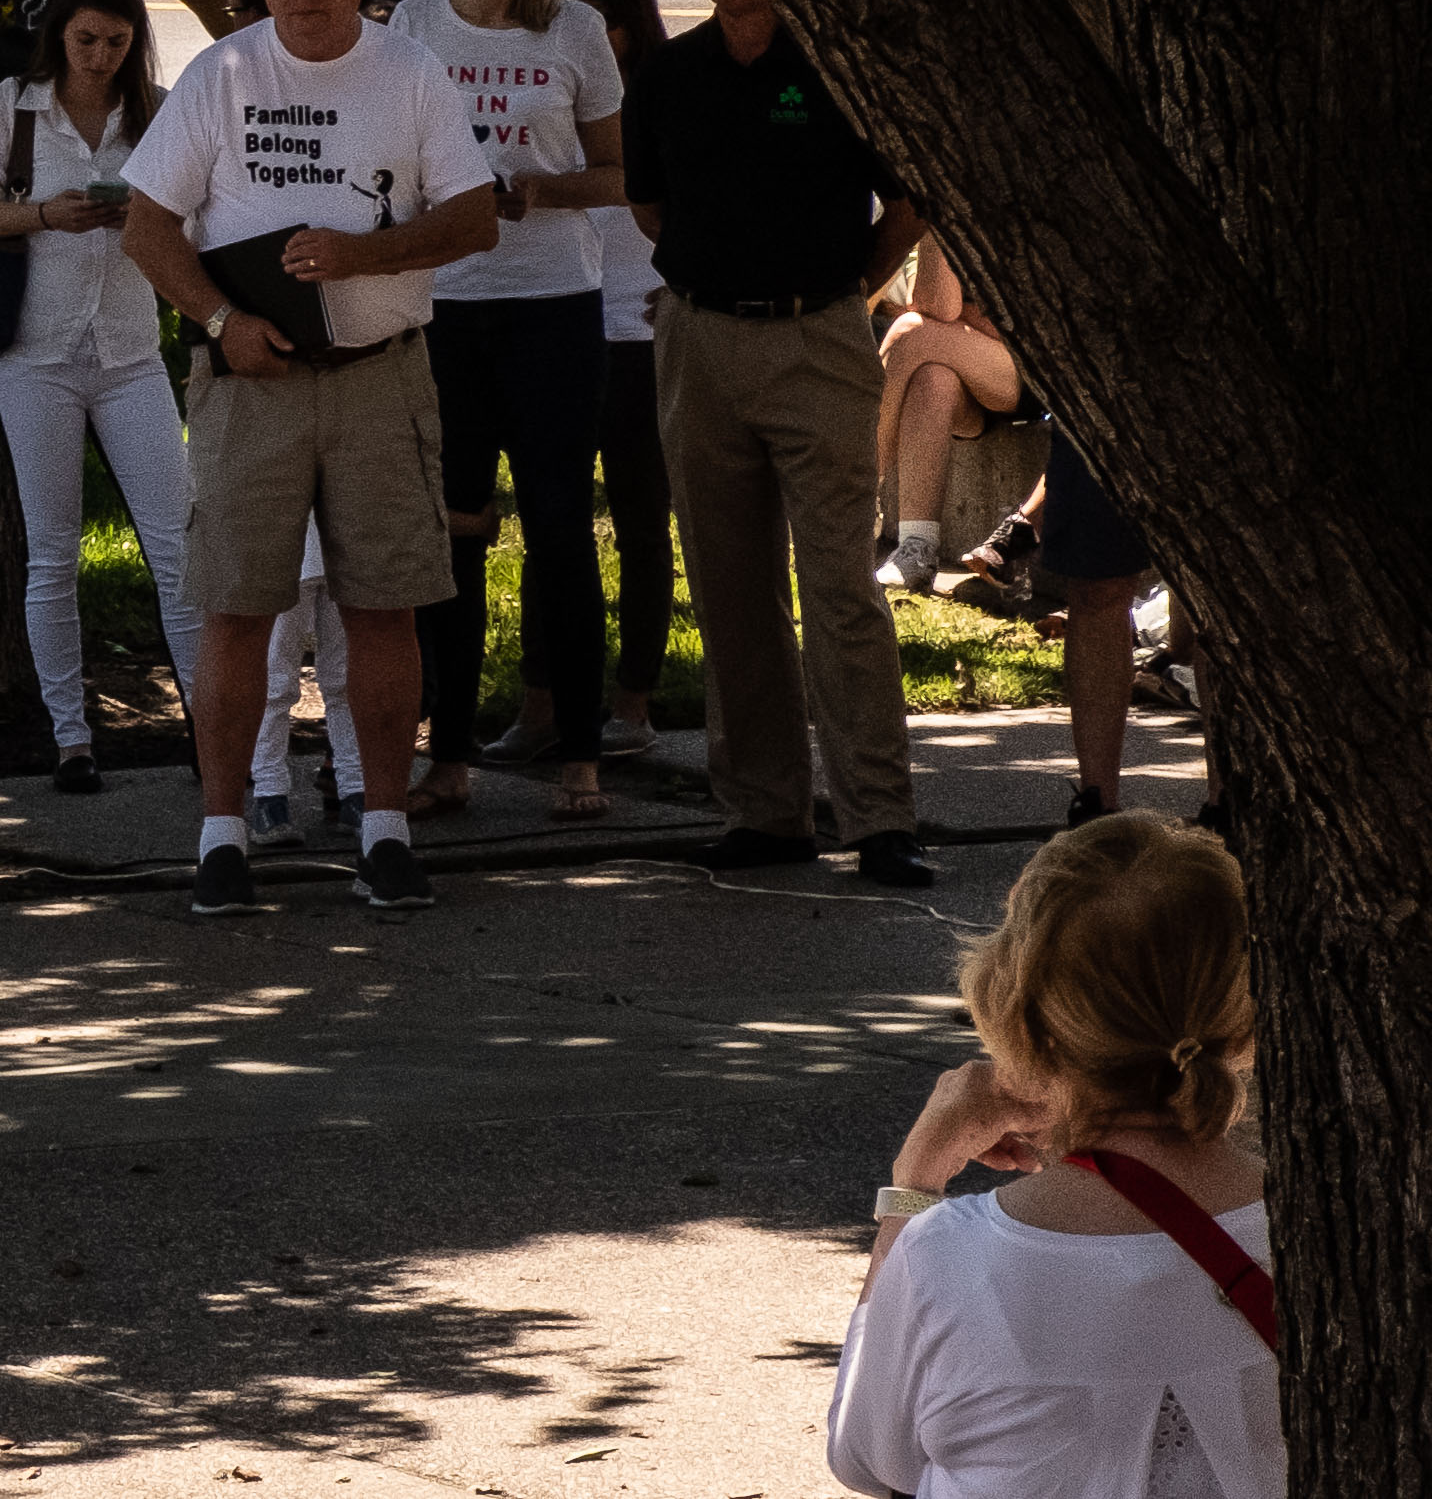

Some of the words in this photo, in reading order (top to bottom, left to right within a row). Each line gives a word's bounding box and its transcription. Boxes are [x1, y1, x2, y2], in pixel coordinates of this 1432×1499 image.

[244, 105, 338, 127] Families
[476, 94, 508, 114] IN
[245, 132, 322, 160] Belong
[246, 161, 346, 189] Together
